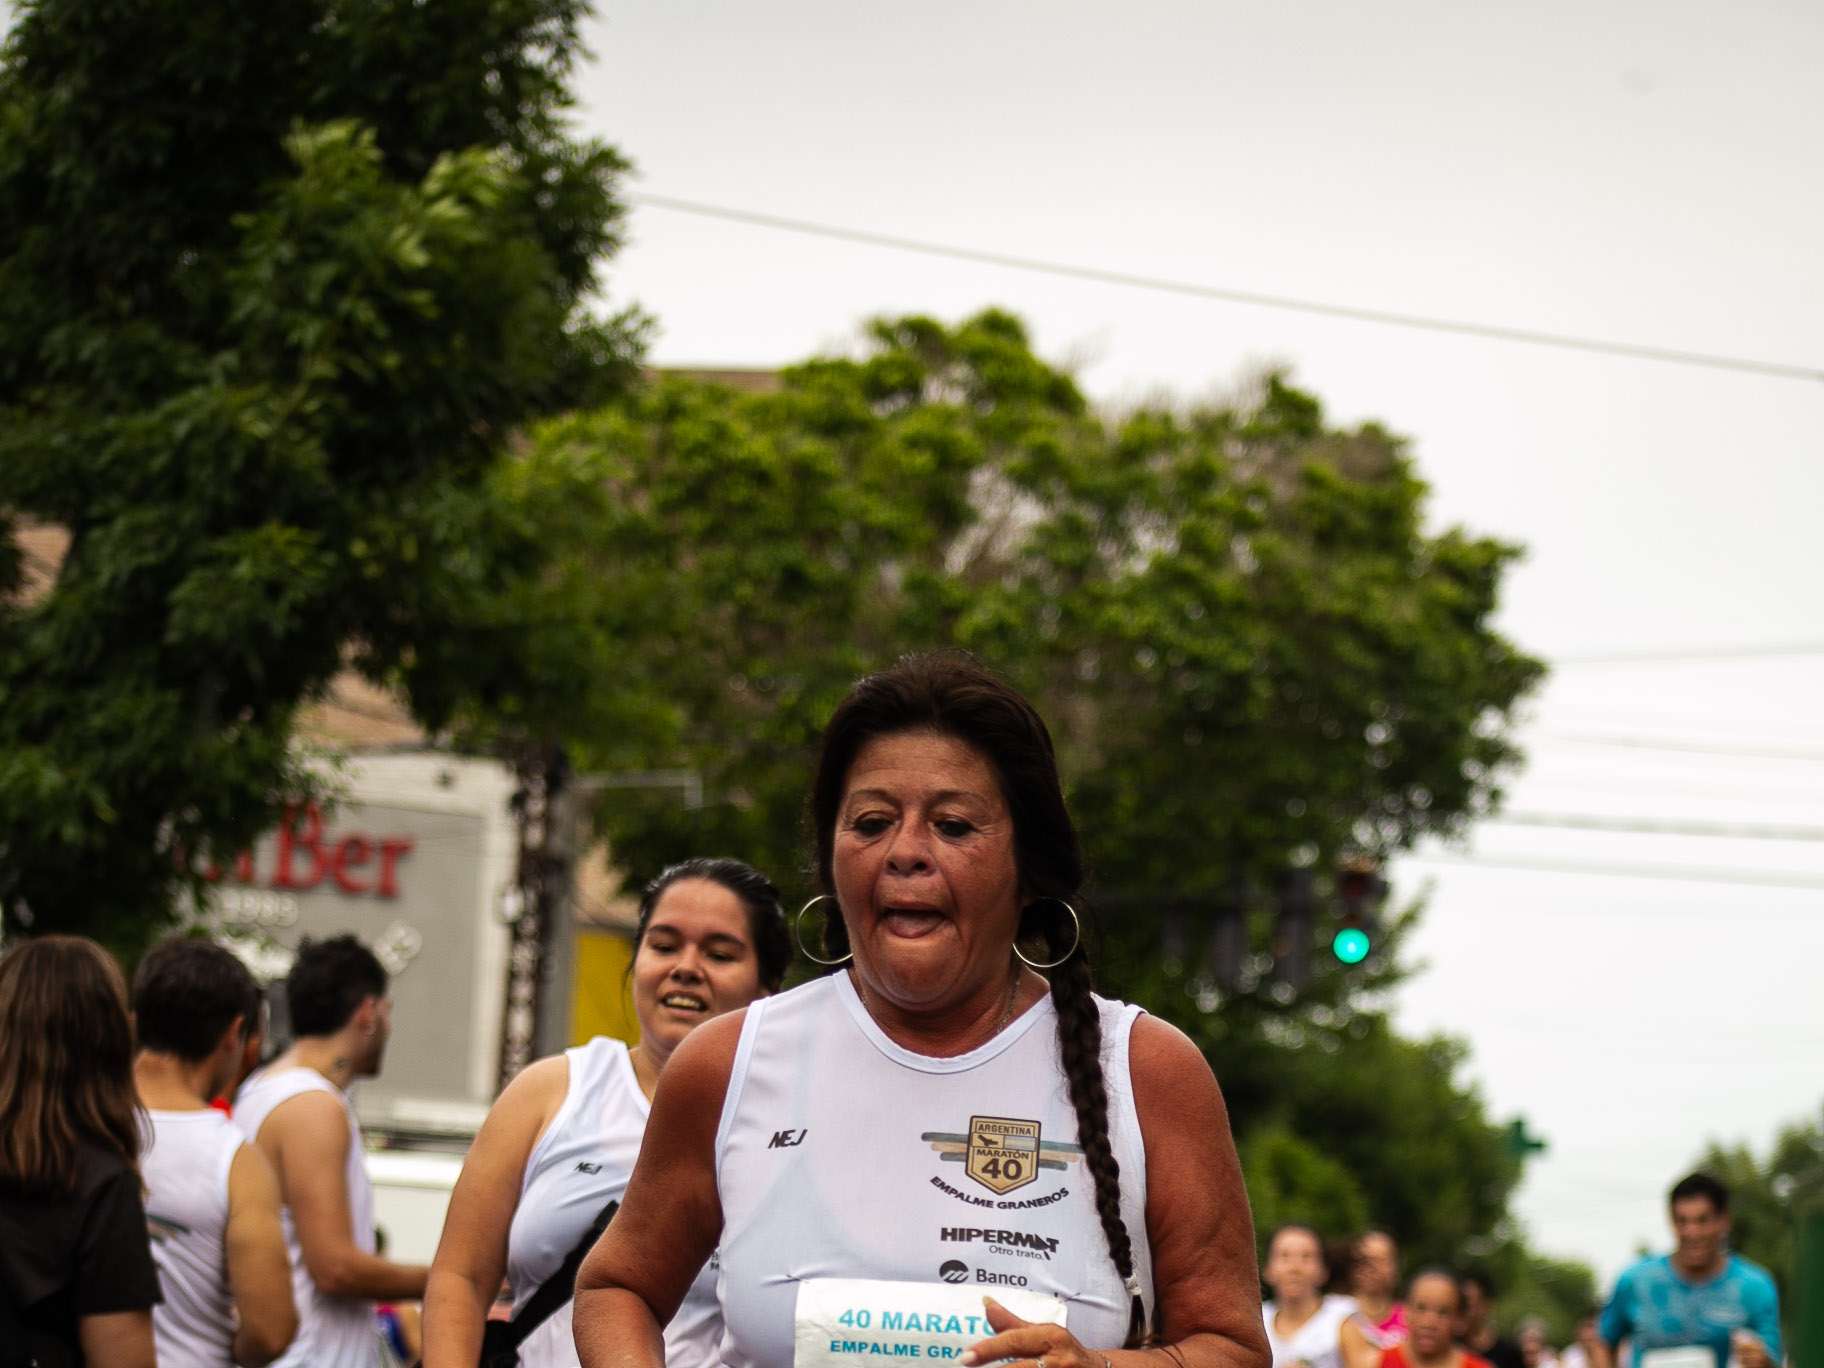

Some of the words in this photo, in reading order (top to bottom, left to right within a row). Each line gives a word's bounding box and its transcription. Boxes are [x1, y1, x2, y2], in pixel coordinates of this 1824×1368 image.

[768, 1128, 808, 1149] NEJ
[977, 1123, 1033, 1136] ARGENTINA
[976, 1149, 1029, 1160] MARATÓN
[981, 1158, 1022, 1181] 40
[930, 1176, 994, 1209] EMPALME
[997, 1187, 1070, 1210] GRANEROS
[989, 1245, 1014, 1256] Otro
[976, 1268, 1028, 1287] Banco
[839, 1309, 871, 1329] 40
[830, 1340, 921, 1357] EMPALME
